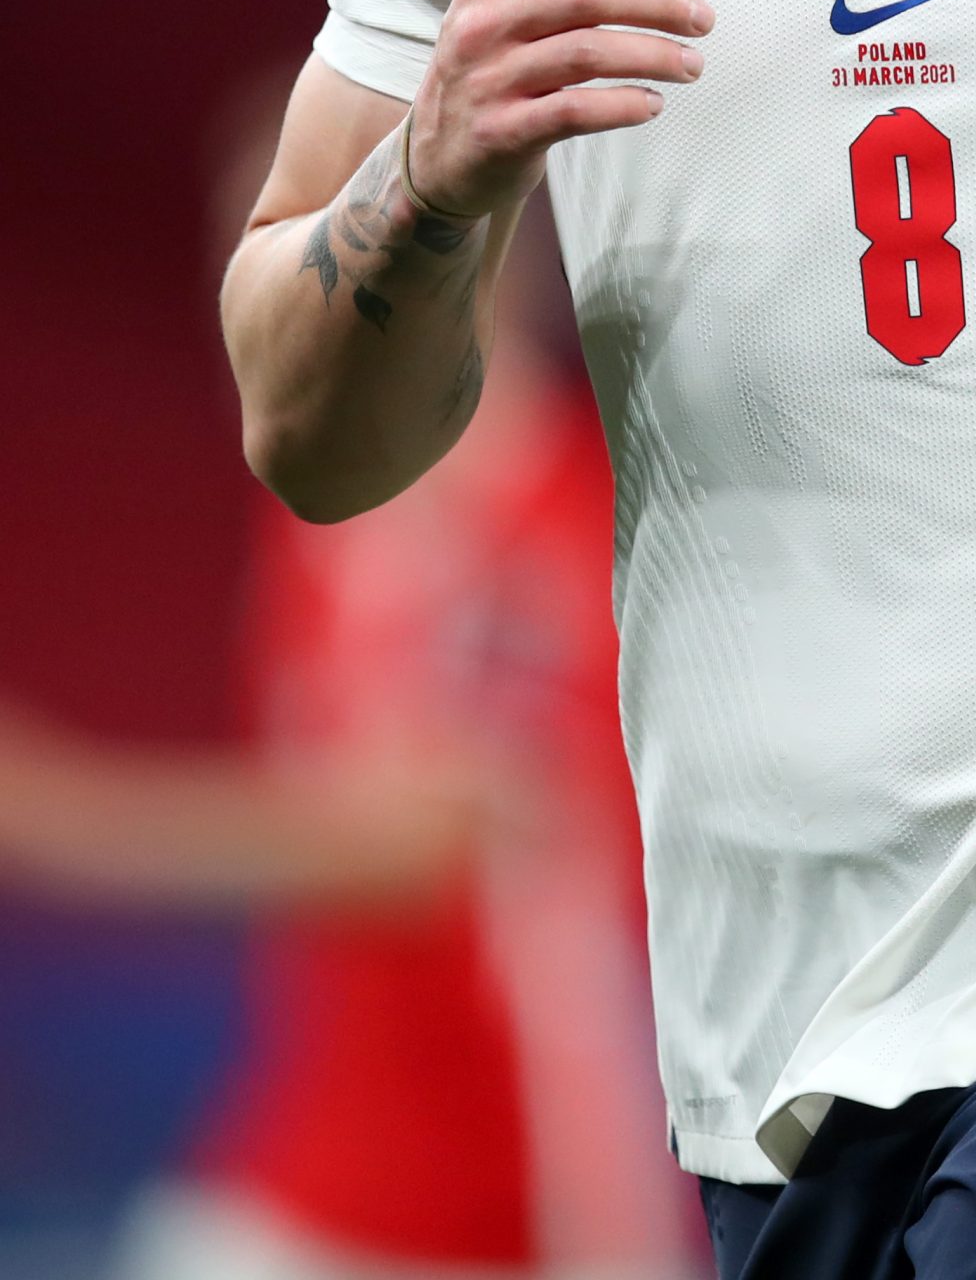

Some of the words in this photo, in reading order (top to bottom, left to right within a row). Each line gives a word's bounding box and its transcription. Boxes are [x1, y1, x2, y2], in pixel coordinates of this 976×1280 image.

[858, 42, 926, 62] POLAND
[831, 68, 848, 87] 31
[853, 66, 915, 86] MARCH
[920, 64, 956, 84] 2021
[849, 106, 967, 366] 8
